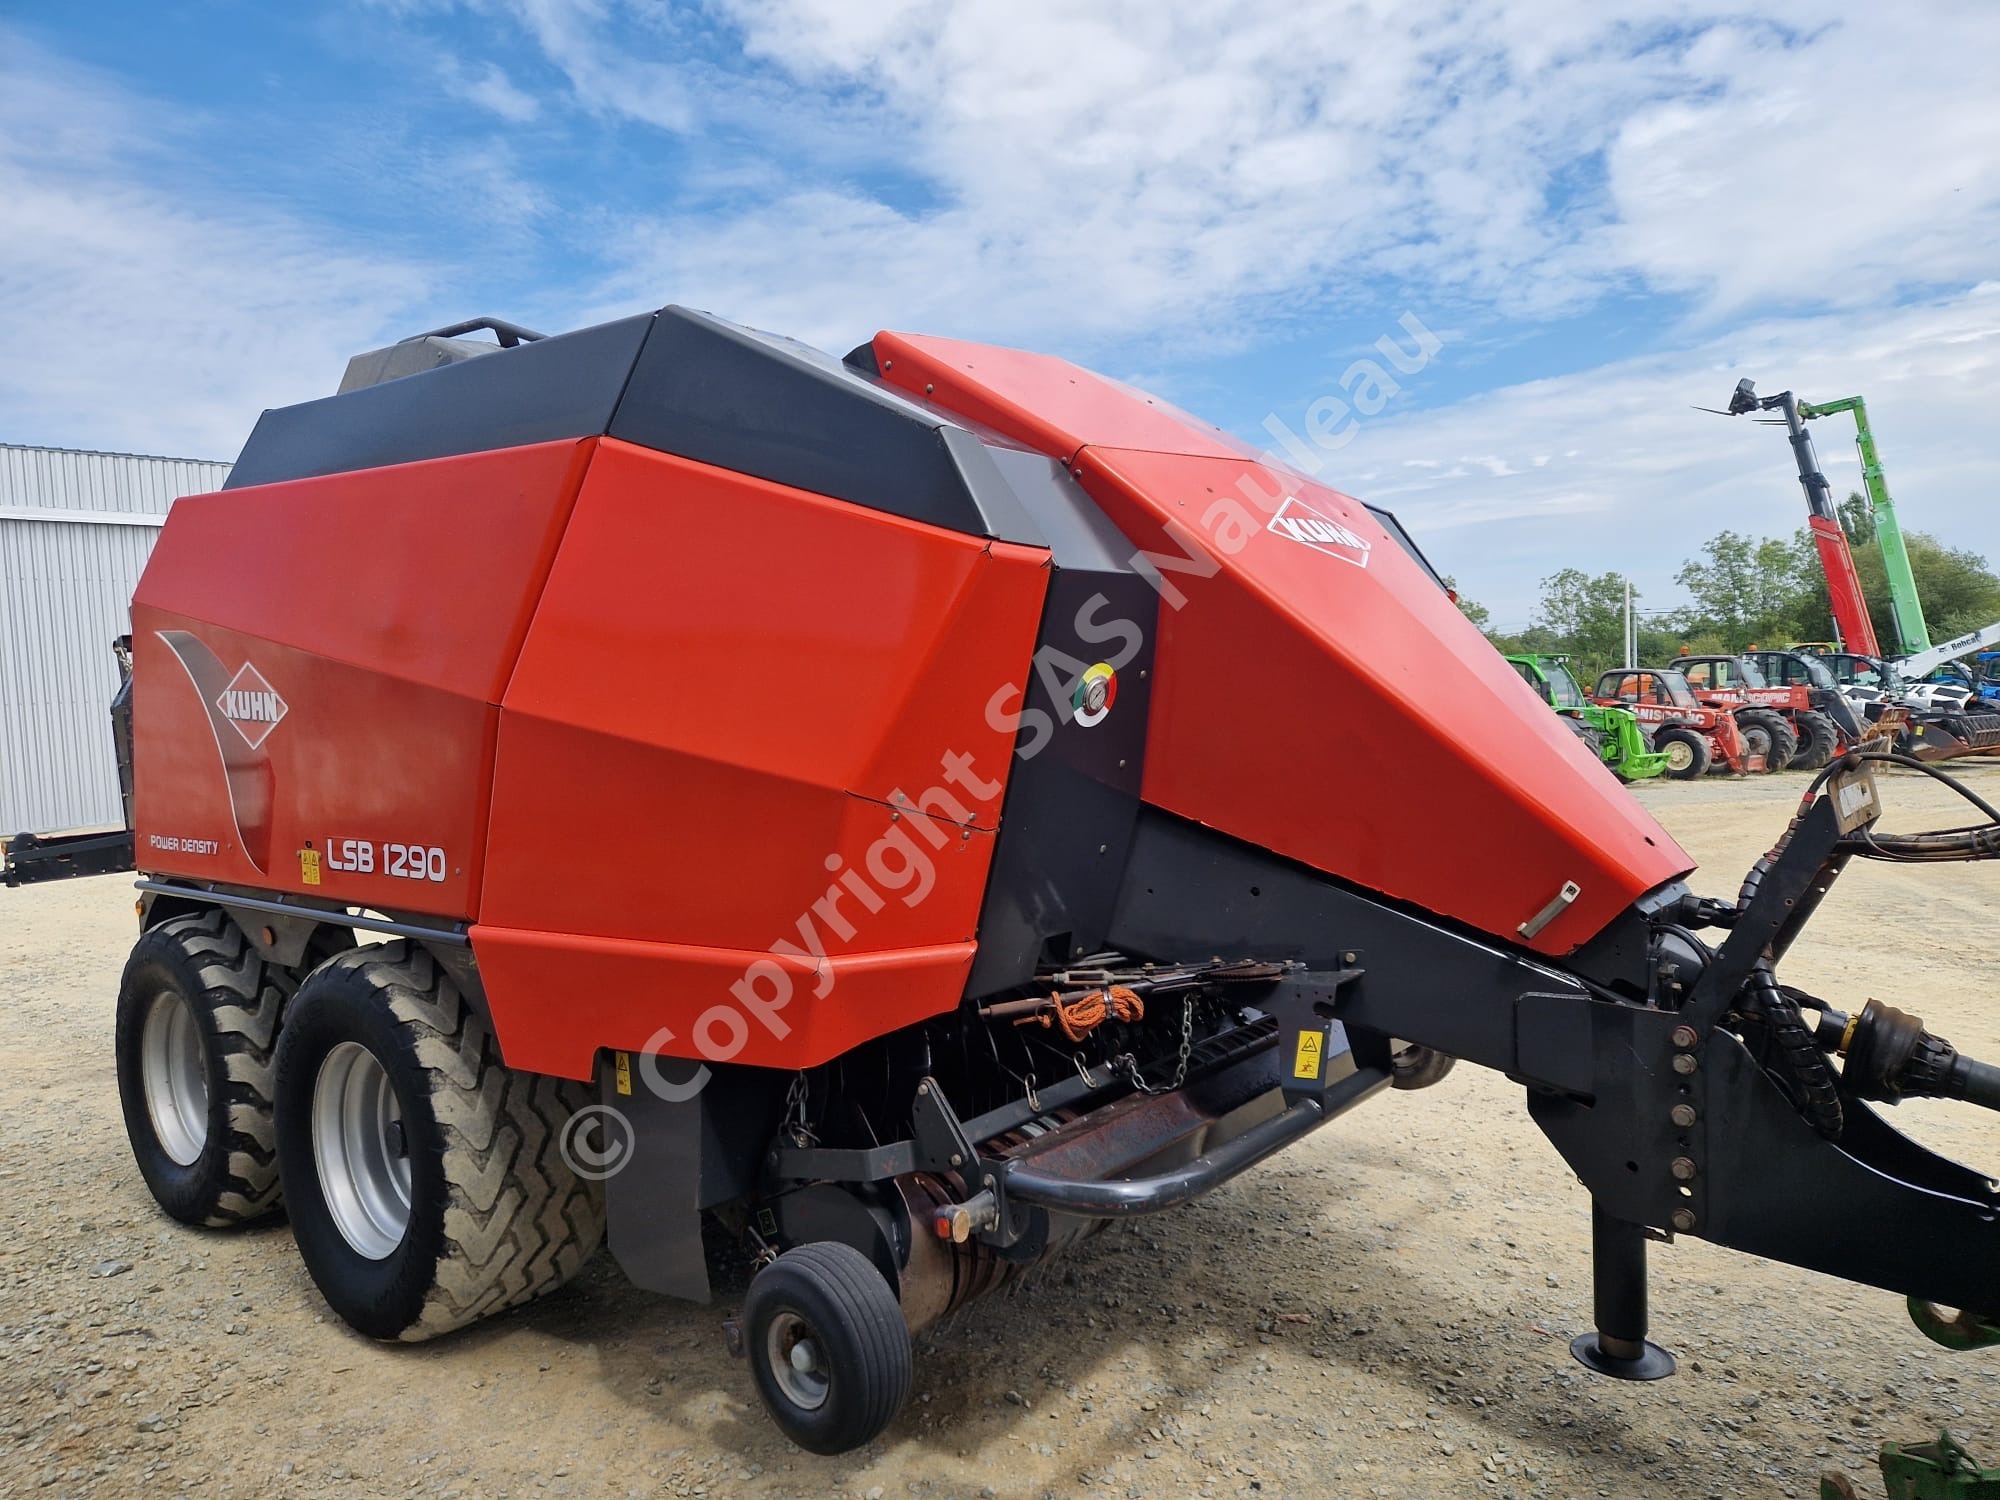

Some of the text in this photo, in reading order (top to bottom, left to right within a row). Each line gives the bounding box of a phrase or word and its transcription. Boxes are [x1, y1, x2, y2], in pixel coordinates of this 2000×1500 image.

[1276, 517, 1371, 551] KUHN
[1951, 634, 1980, 651] Bobcat
[226, 690, 278, 722] KUHN
[150, 834, 218, 855] POWER DENSITY
[327, 838, 446, 883] LSB 1290
